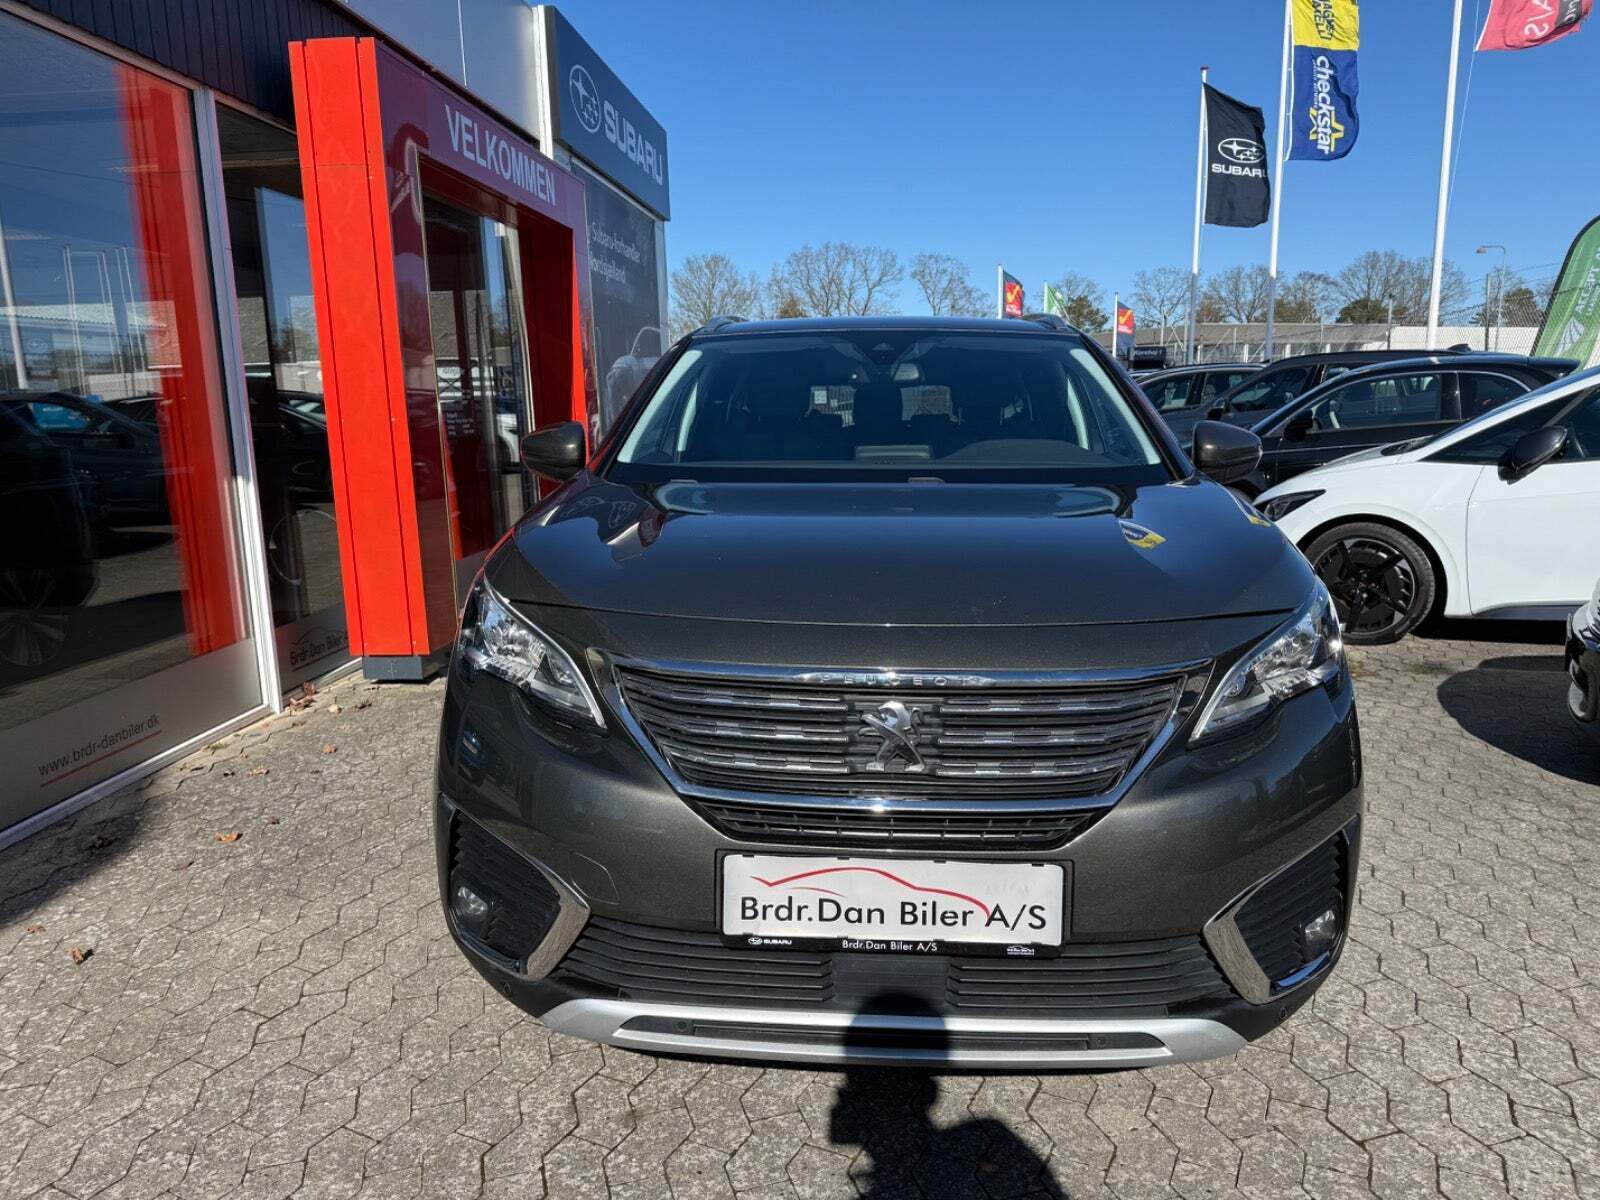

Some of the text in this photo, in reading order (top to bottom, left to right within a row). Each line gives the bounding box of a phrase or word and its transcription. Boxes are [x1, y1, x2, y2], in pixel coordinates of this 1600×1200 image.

[1316, 55, 1336, 154] checkstar
[445, 103, 556, 206] VELKOMMEN
[603, 100, 663, 185] SUBARU
[38, 713, 161, 776] www.brdr-danbiler.dk
[890, 940, 913, 951] Biler
[917, 942, 938, 952] A/S
[899, 901, 974, 926] Biler
[985, 903, 1047, 931] A/S
